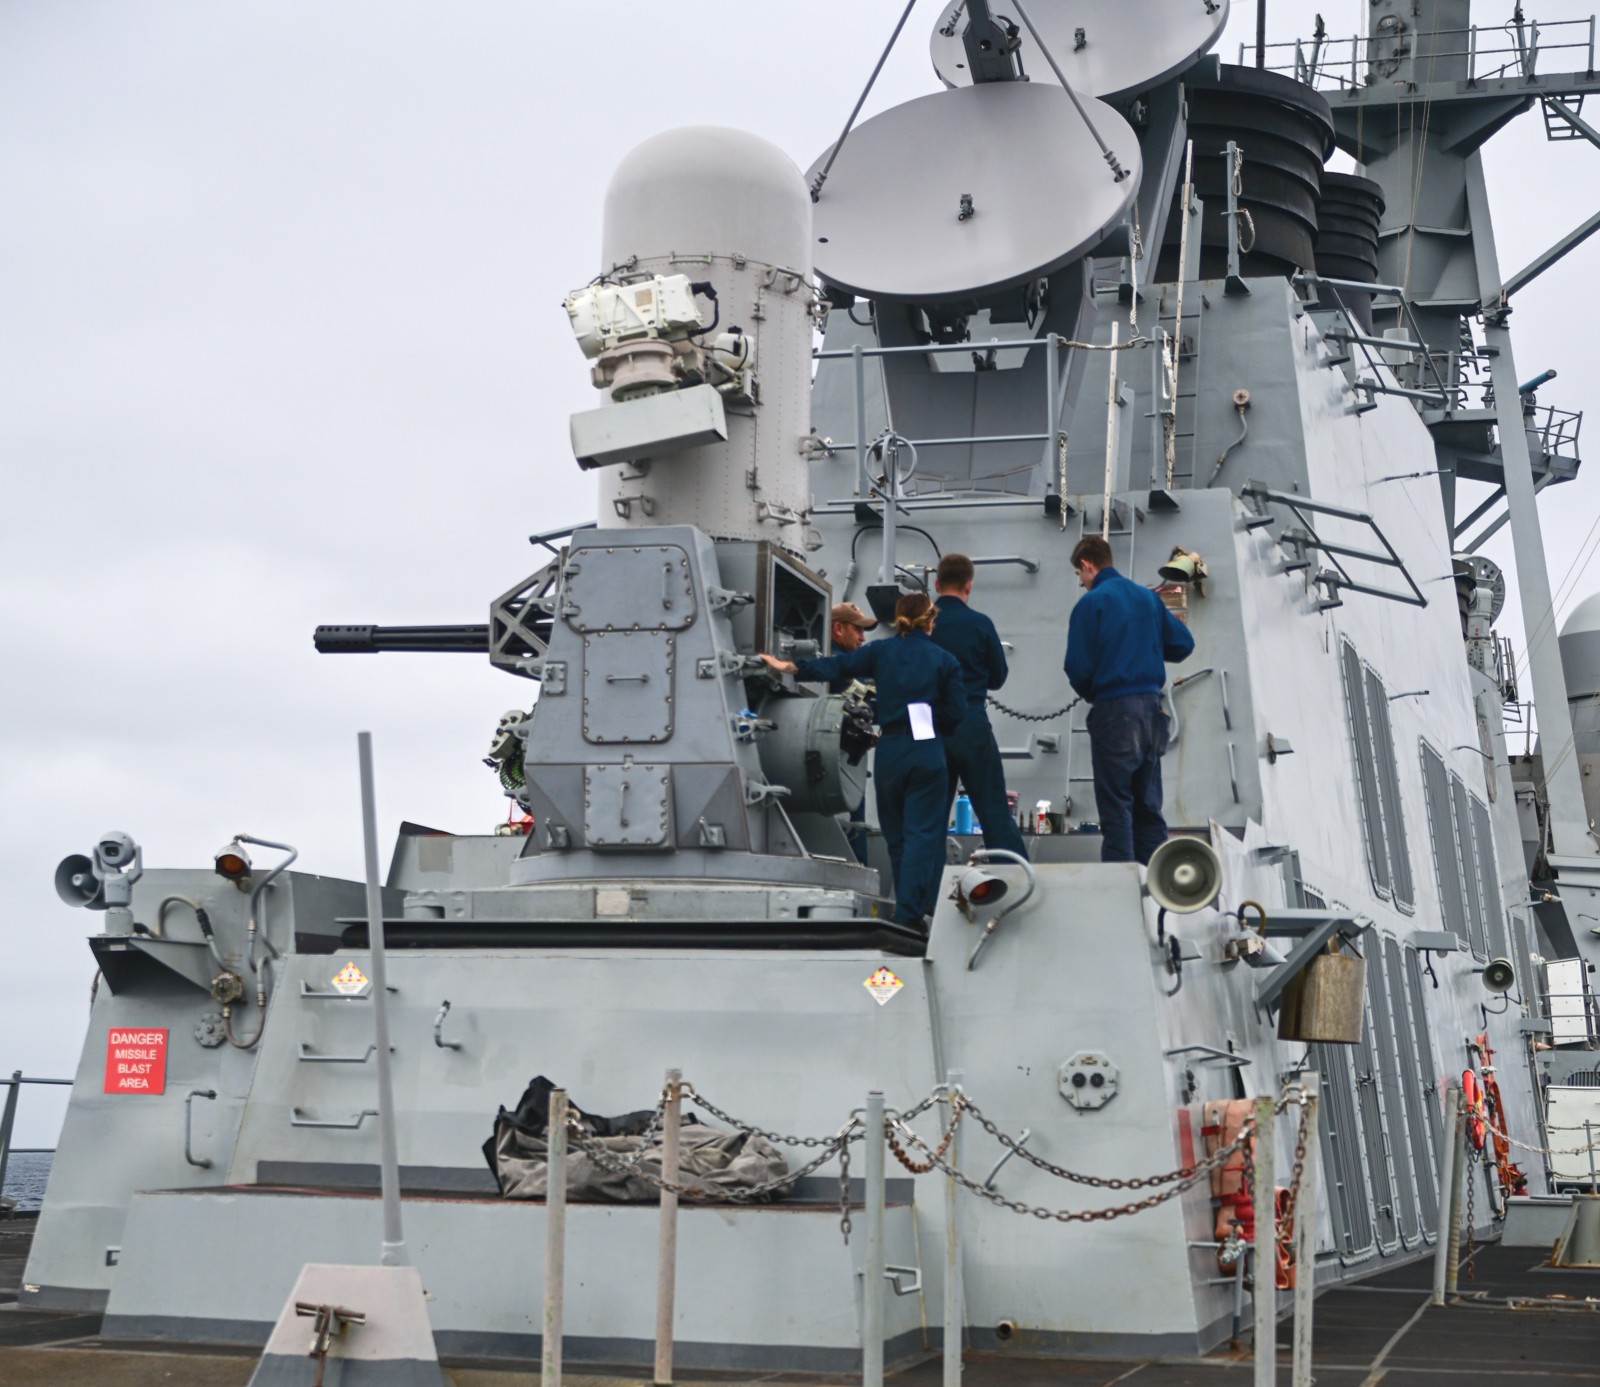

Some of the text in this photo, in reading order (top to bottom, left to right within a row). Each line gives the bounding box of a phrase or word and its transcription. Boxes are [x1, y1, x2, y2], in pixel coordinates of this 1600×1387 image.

[111, 1033, 164, 1045] DANGER
[115, 1049, 157, 1060] MISSILE
[117, 1063, 152, 1074] BLAST
[118, 1078, 149, 1088] AREA
